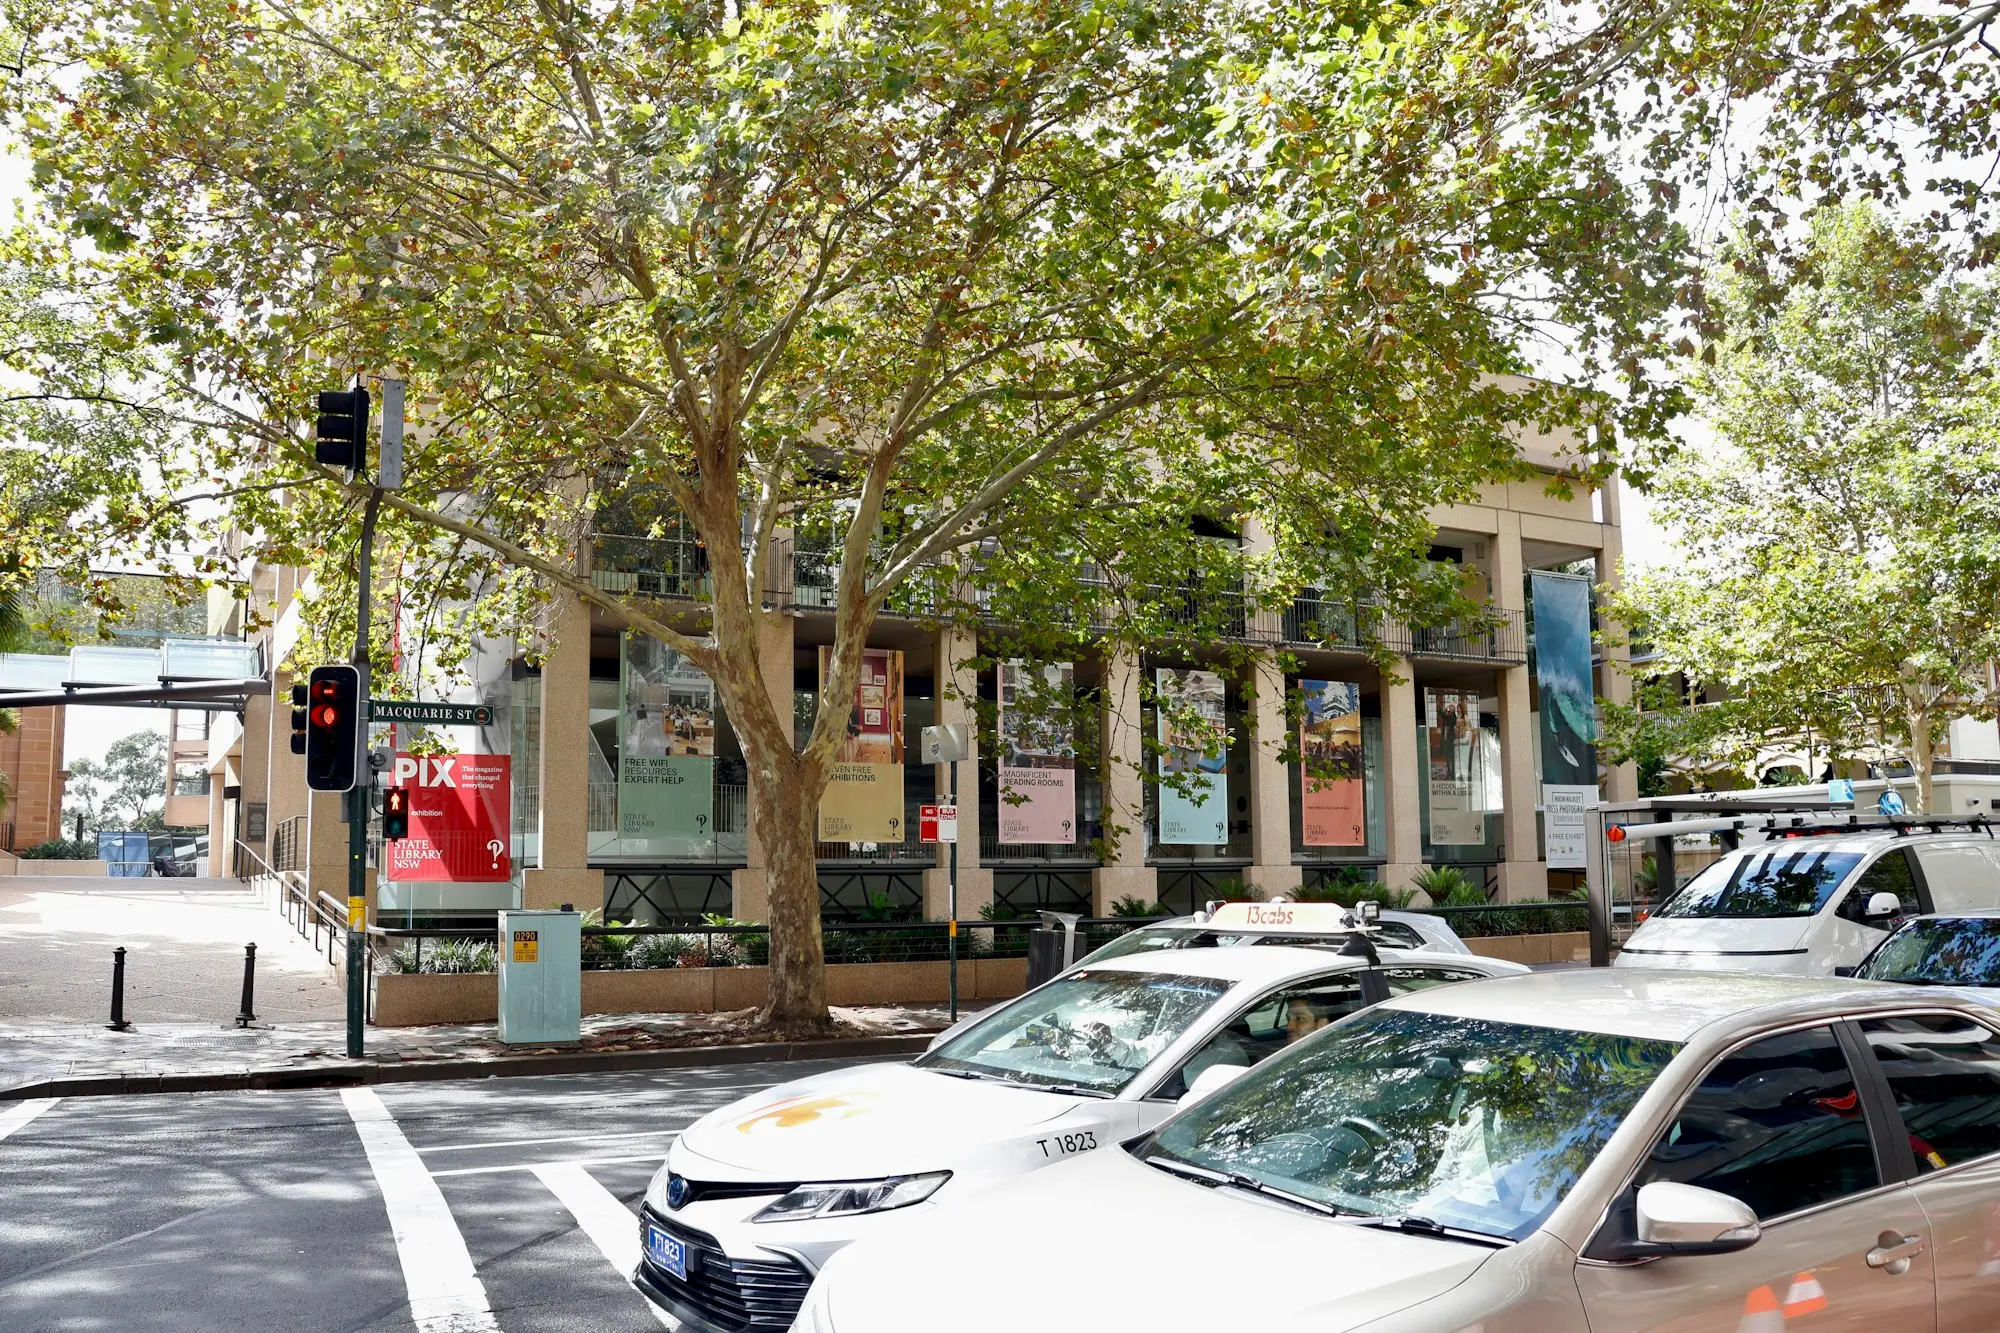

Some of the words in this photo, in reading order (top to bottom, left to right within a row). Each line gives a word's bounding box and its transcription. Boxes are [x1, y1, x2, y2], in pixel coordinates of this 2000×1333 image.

[375, 706, 453, 719] MACQUARIE
[457, 709, 472, 720] ST
[625, 758, 647, 767] FREE
[649, 759, 668, 767] WIFI
[395, 757, 457, 788] PIX
[624, 767, 678, 776] RESOURCES
[852, 766, 872, 774] FREE
[1004, 770, 1052, 779] MAGNIFICENT
[624, 776, 660, 784] EXPERT
[661, 776, 684, 785] HELP
[829, 773, 876, 782] XHIBITIONS
[1004, 778, 1036, 786] READING
[462, 782, 494, 790] everything
[410, 809, 443, 817] exhibition
[1546, 804, 1559, 813] PRESS
[1560, 804, 1584, 813] PHOTOGRA
[394, 840, 429, 849] STATE
[394, 850, 444, 859] LIBRARY
[394, 860, 421, 868] NSW
[1246, 905, 1294, 925] 13cabs
[515, 932, 536, 941] 0290
[1036, 1139, 1049, 1157] T
[1054, 1131, 1097, 1154] 1823
